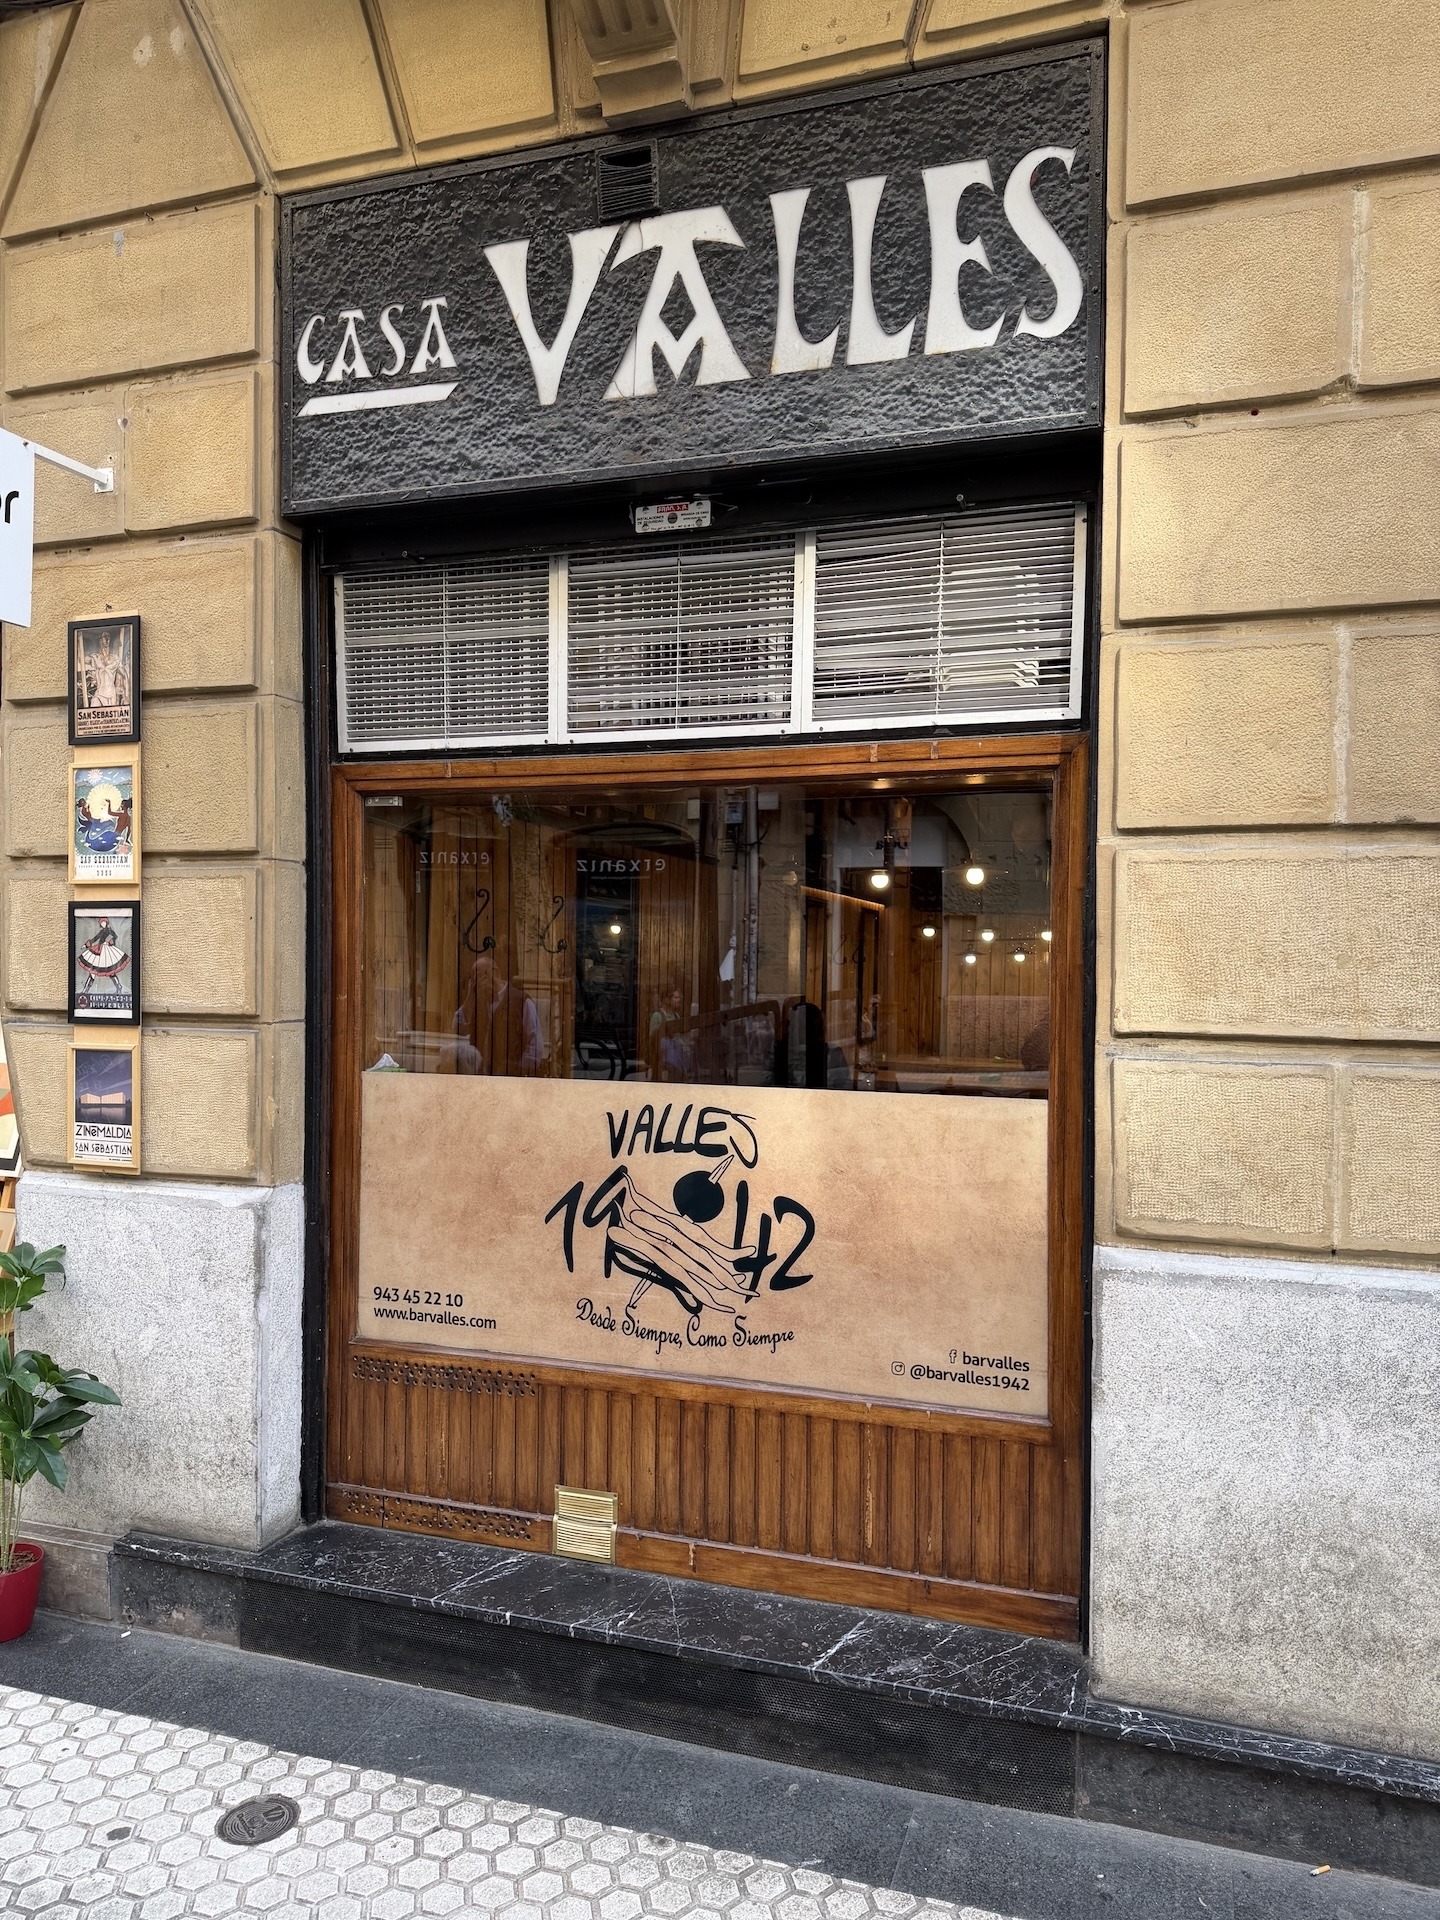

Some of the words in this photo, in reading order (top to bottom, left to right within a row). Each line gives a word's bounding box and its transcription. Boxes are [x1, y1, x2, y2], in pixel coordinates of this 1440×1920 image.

[297, 296, 457, 384] CASA
[482, 146, 1084, 405] VALLES
[78, 711, 92, 720] SAN
[75, 1142, 89, 1152] SAN
[606, 1103, 758, 1169] VALLES
[373, 1286, 399, 1302] 943
[403, 1289, 420, 1304] 45
[424, 1291, 442, 1306] 22
[445, 1293, 464, 1307] 10
[373, 1307, 497, 1329] www.barvalles.com
[575, 1297, 617, 1332] Desde
[686, 1314, 727, 1347] Como
[732, 1315, 795, 1353] Siempre
[962, 1351, 1030, 1372] barvalles
[910, 1364, 1030, 1391] @barvalles1942
